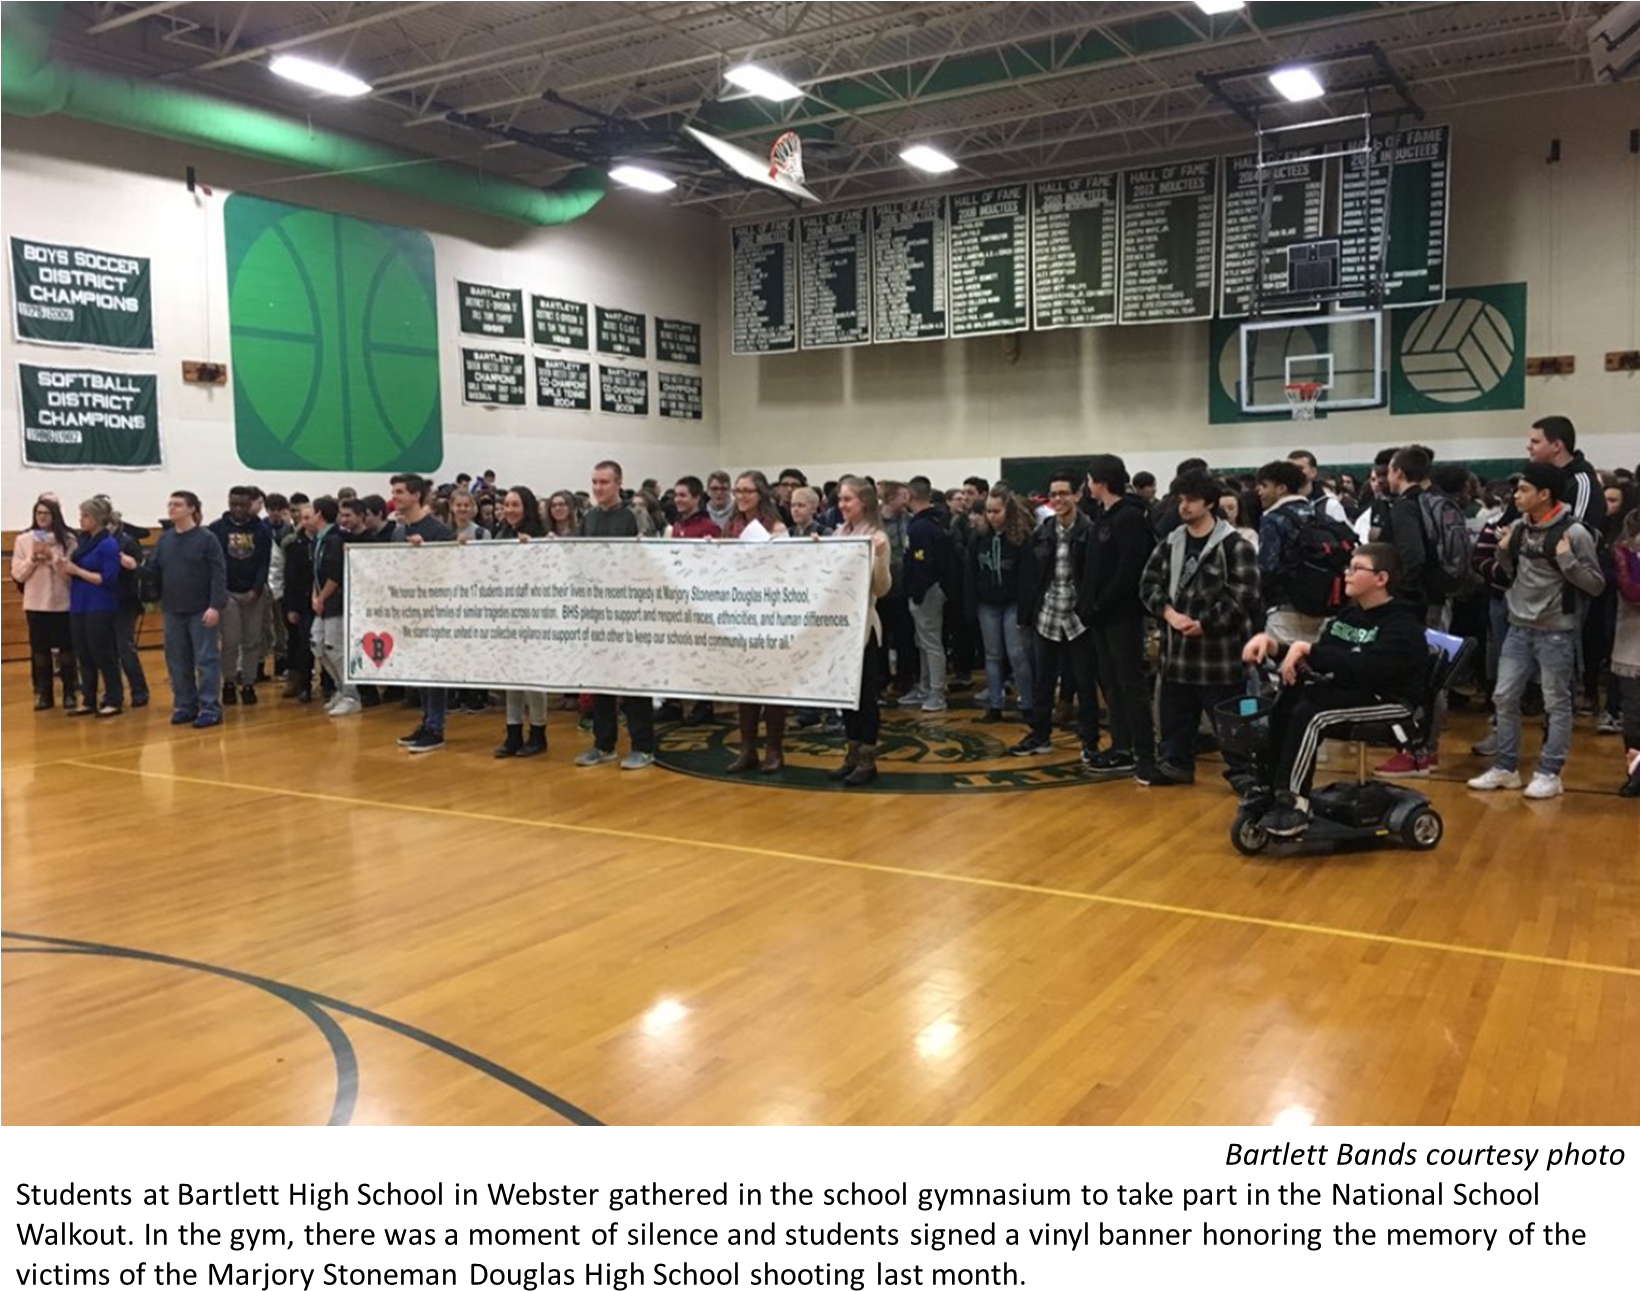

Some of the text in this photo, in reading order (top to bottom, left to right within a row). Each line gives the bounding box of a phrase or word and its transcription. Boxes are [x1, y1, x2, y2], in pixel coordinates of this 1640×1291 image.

[1406, 127, 1444, 147] FAME
[1129, 161, 1210, 186] HALL OF FAME
[1159, 176, 1207, 193] INDUCTEES
[23, 244, 139, 275] BOYS SOCCER
[39, 266, 128, 292] DISTRICT
[30, 285, 139, 313] CHAMPIONS
[470, 286, 511, 300] BARTLETT
[540, 299, 580, 314] BARTLETT
[604, 311, 637, 324] BARTLETT
[473, 351, 515, 365] BARTLETT
[545, 359, 581, 372] BARTLETT
[38, 371, 140, 393] SOFTBALL
[474, 371, 517, 385] CHAMPIONS
[607, 367, 641, 380] BARTLETT
[47, 391, 134, 411] DISTRICT
[38, 410, 146, 430] CHAMPIONS
[417, 586, 427, 599] the
[428, 587, 453, 602] memory
[460, 585, 469, 599] the
[479, 586, 504, 599] students
[505, 586, 514, 598] and
[551, 584, 569, 599] their
[570, 585, 587, 599] lives
[593, 586, 604, 599] the
[605, 586, 627, 599] recent
[628, 586, 655, 603] tragedy
[662, 586, 690, 604] Marjory
[690, 586, 731, 602] Stoneman
[732, 586, 762, 607] Douglas
[763, 587, 781, 607] High
[781, 587, 811, 604] School,
[463, 605, 483, 618] similar
[484, 605, 510, 622] tragedies
[511, 608, 531, 618] across
[562, 604, 580, 620] BHS
[580, 606, 606, 624] pledges
[606, 608, 613, 621] to
[614, 608, 642, 625] support
[643, 608, 657, 622] and
[658, 609, 683, 626] respect
[684, 608, 693, 623] all
[693, 611, 716, 626] races,
[717, 610, 759, 627] ethnicities,
[760, 611, 775, 626] and
[775, 611, 803, 627] human
[803, 610, 851, 628] differences.
[372, 637, 386, 662] B
[413, 627, 430, 639] stand
[453, 626, 473, 639] united
[490, 627, 517, 640] collective
[552, 627, 582, 644] support
[582, 626, 590, 641] of
[591, 628, 606, 642] each
[607, 628, 625, 643] other
[634, 629, 652, 647] keep
[653, 632, 665, 645] our
[666, 630, 693, 646] schools
[694, 632, 707, 647] and
[708, 633, 748, 653] community
[749, 633, 766, 650] safe
[766, 633, 778, 650] for
